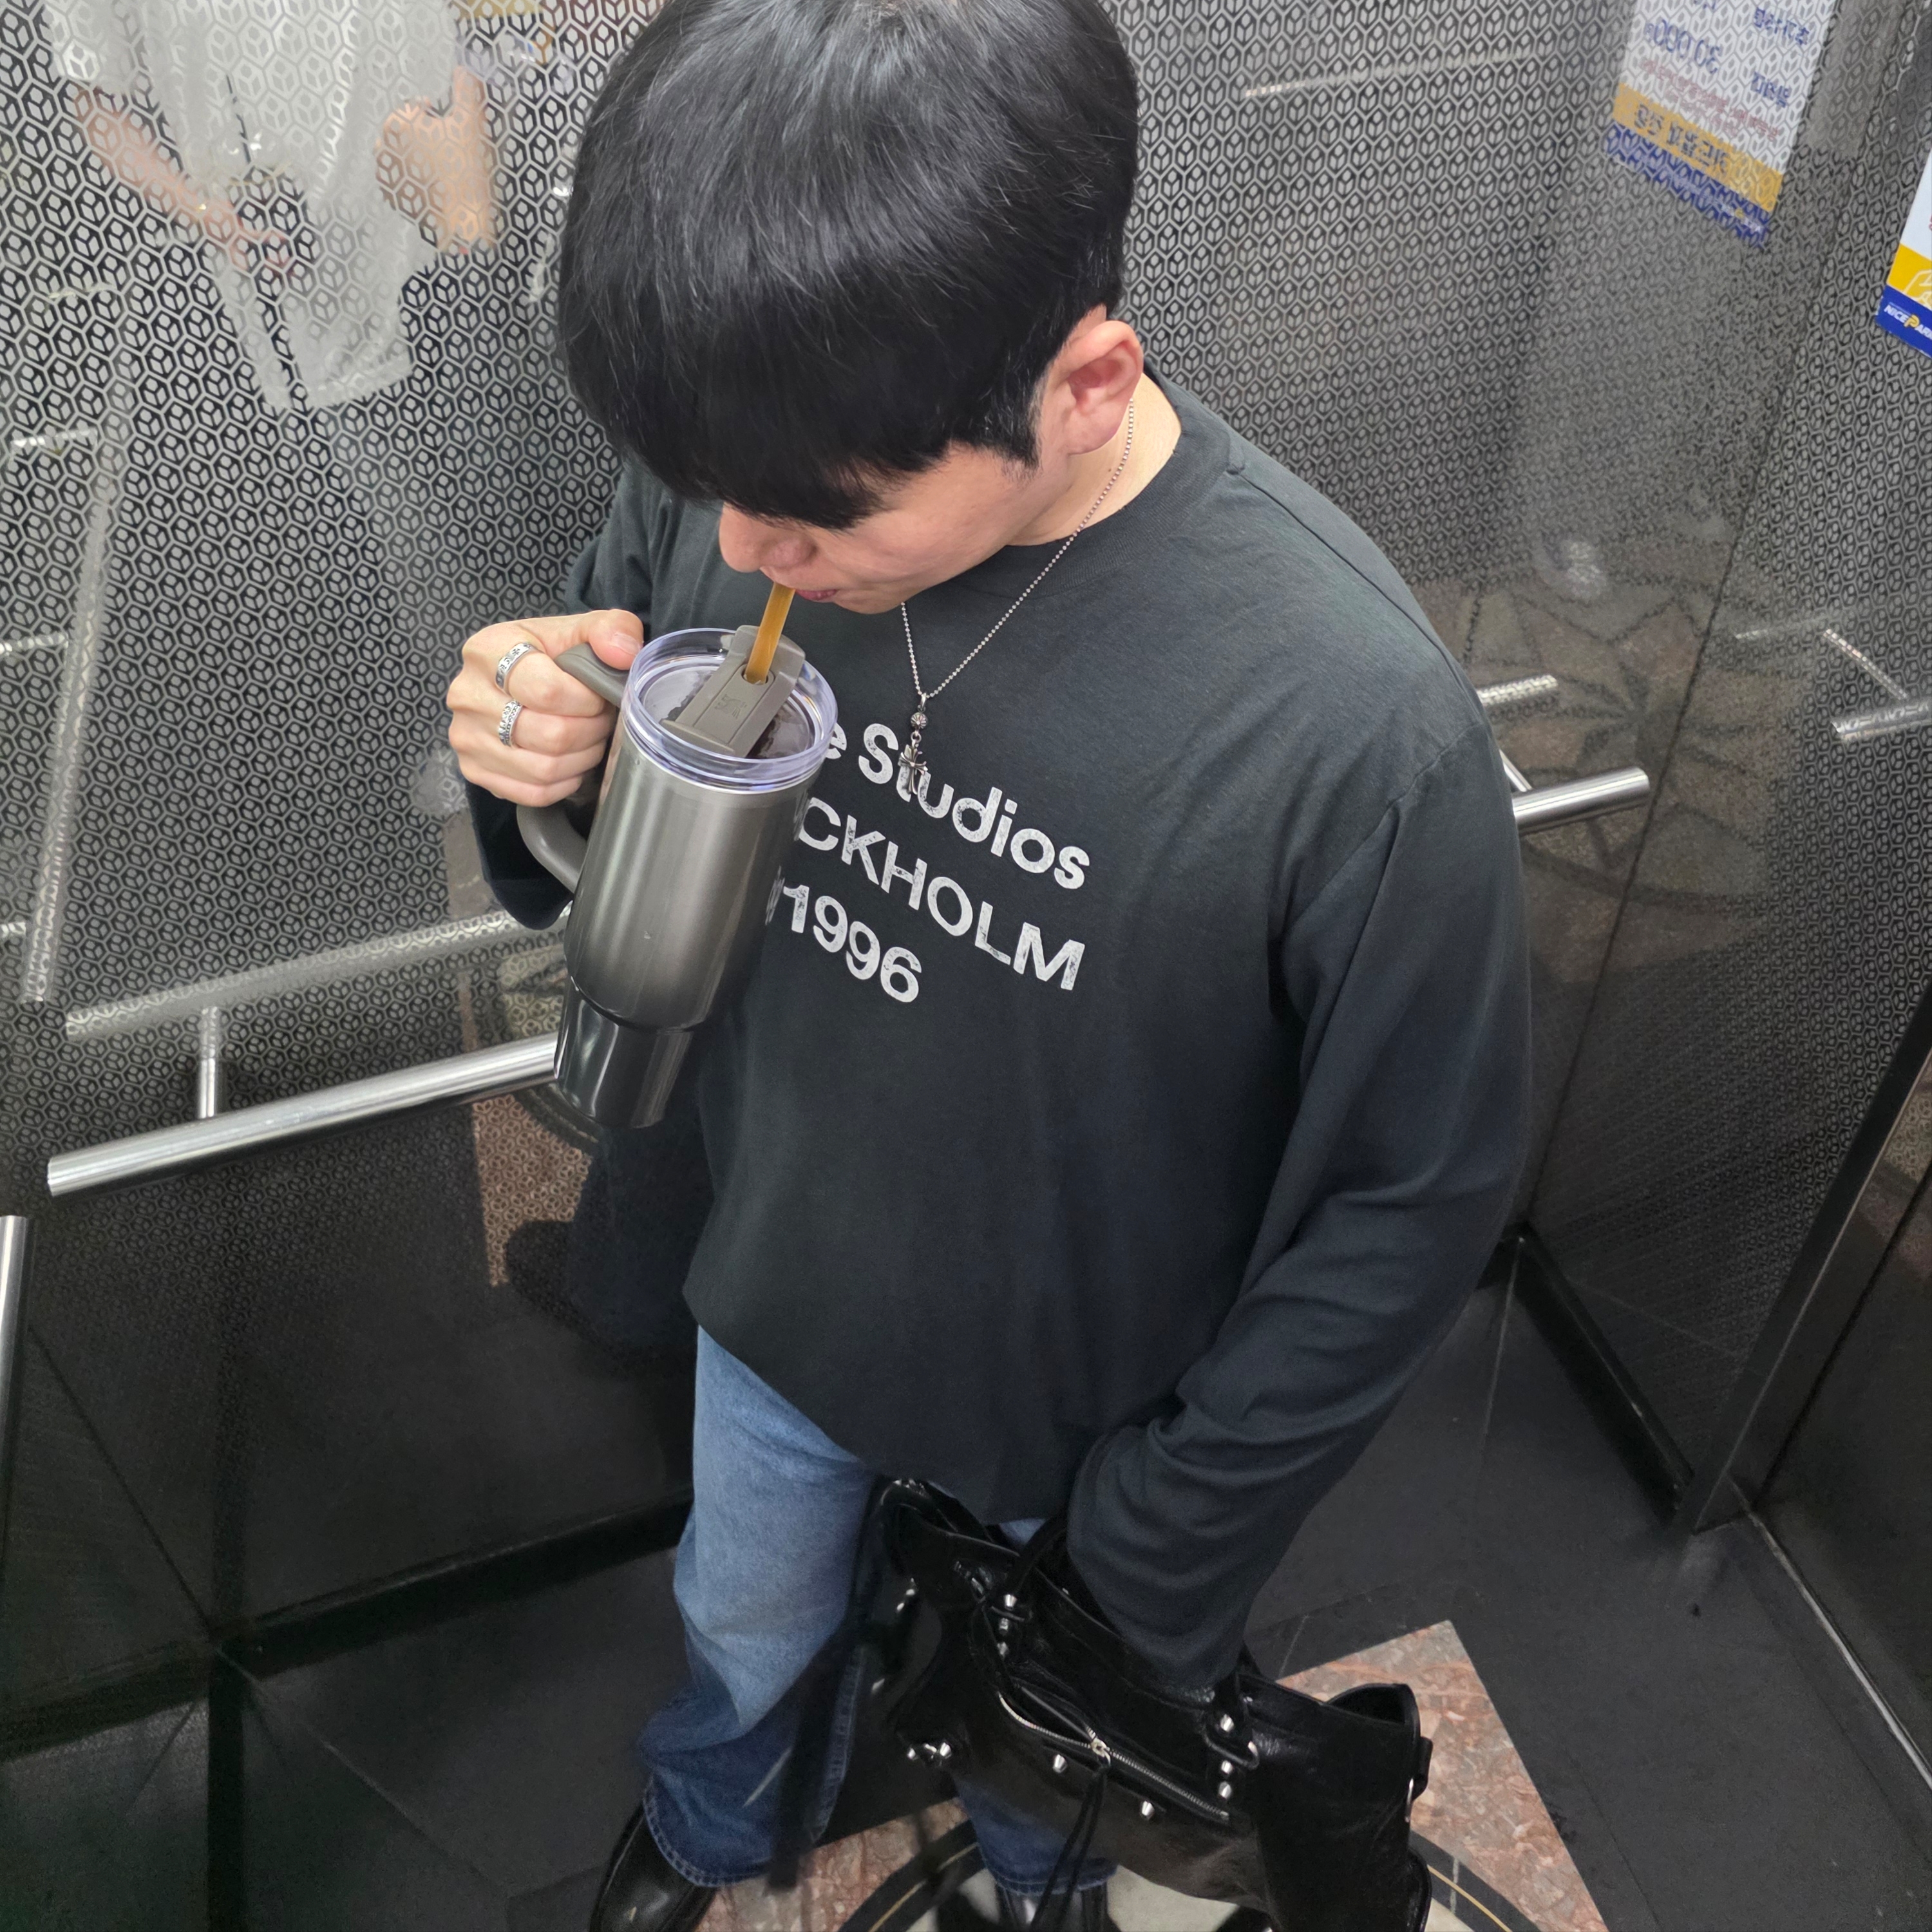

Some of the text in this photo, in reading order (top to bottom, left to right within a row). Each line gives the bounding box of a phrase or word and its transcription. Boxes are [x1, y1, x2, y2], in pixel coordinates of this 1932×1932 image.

[1884, 305, 1932, 340] NICEPAR
[783, 884, 922, 1003] 1996
[798, 797, 1085, 991] CKHOLM
